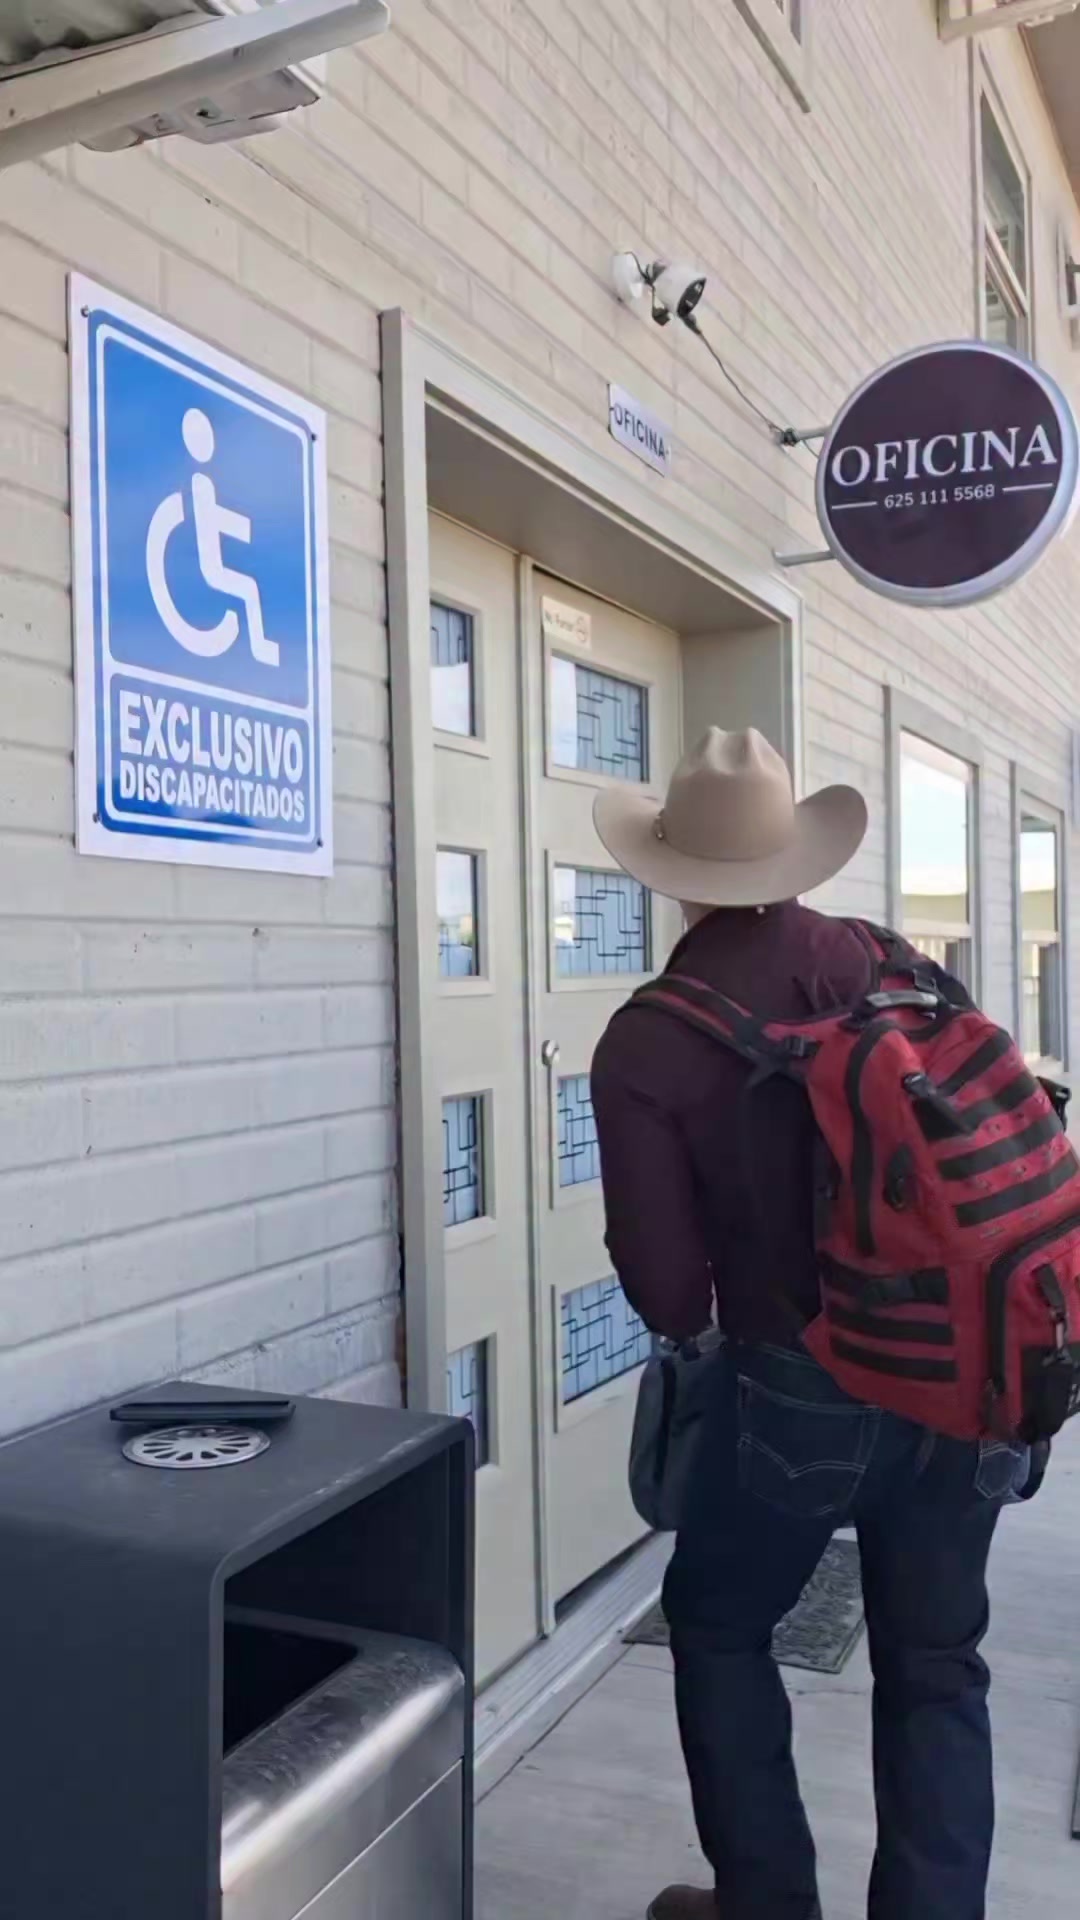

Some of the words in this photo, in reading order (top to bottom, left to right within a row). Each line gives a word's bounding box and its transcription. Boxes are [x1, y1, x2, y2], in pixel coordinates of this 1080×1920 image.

[614, 402, 665, 460] OFICINA
[831, 424, 1057, 487] OFICINA
[884, 492, 914, 509] 625
[920, 489, 948, 505] 111
[954, 484, 995, 501] 5568
[119, 690, 304, 784] EXCLUSIVO
[119, 760, 305, 823] DISCAPACITADOS
